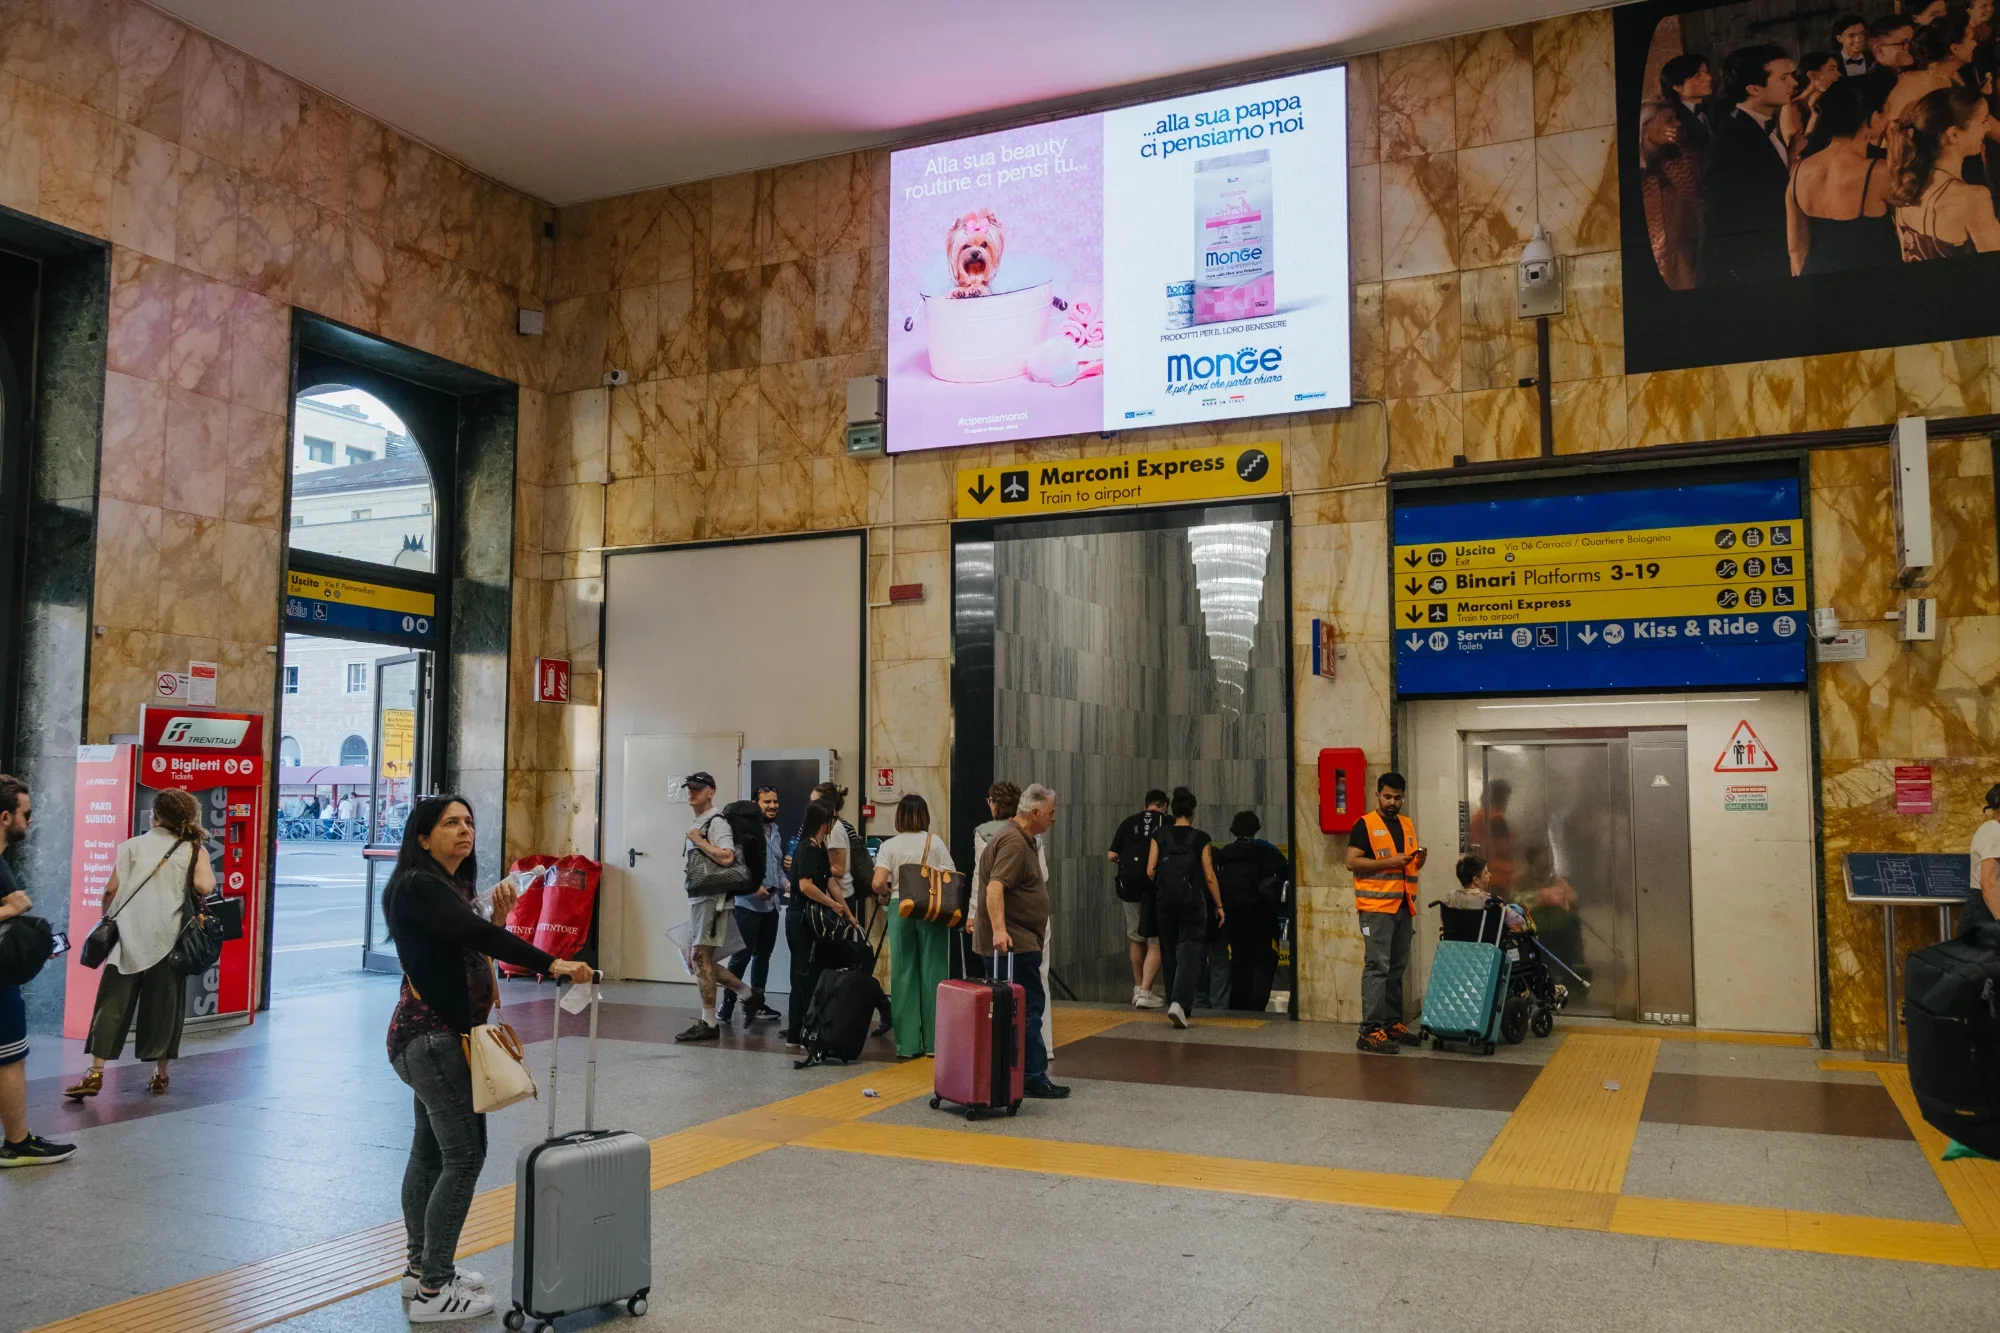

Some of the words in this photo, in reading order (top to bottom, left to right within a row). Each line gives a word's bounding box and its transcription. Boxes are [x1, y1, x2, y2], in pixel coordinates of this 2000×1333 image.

[1144, 114, 1189, 136] ...alla
[1195, 108, 1230, 127] sua
[1235, 95, 1301, 124] pappa
[1140, 138, 1157, 158] ci
[1162, 124, 1264, 159] pensiamo
[1269, 112, 1304, 136] noi
[924, 157, 959, 176] Alla
[963, 152, 995, 169] sua
[1000, 138, 1068, 163] beauty
[904, 175, 972, 200] routine
[976, 169, 992, 187] ci
[997, 159, 1048, 188] pensi
[1054, 157, 1088, 174] tu...
[1160, 331, 1199, 342] PRODOTTI
[1200, 330, 1213, 338] PER
[1223, 325, 1244, 335] LORO
[1245, 320, 1287, 331] BENESSERE
[1173, 384, 1188, 396] pet
[1188, 380, 1209, 395] food
[1210, 378, 1224, 389] che
[1225, 376, 1252, 390] parla
[1254, 373, 1282, 384] chiaro
[958, 410, 1028, 427] #cipensiamonoi
[1040, 461, 1129, 486] Marconi
[1138, 457, 1225, 480] Express
[1040, 490, 1071, 505] Train
[1076, 490, 1090, 501] to
[1095, 485, 1142, 502] airport
[1456, 544, 1496, 557] Uscita
[1504, 542, 1518, 551] Via
[1536, 539, 1572, 550] Carracci
[1582, 536, 1624, 547] Quartiere
[1627, 533, 1671, 546] Bolognina
[1456, 558, 1470, 566] Exit
[291, 575, 319, 588] Uscita
[1456, 571, 1516, 589] Binari
[1524, 568, 1601, 586] Platforms
[1610, 563, 1660, 581] 3-19
[291, 585, 301, 593] Exit
[1457, 600, 1513, 612] Marconi
[1517, 598, 1571, 612] Express
[1457, 613, 1477, 622] Train
[1480, 613, 1489, 621] to
[1491, 612, 1520, 623] airport
[1457, 628, 1503, 641] Servizi
[1633, 621, 1677, 639] Kiss
[1684, 620, 1702, 637] &
[1708, 617, 1759, 636] Ride
[1457, 642, 1483, 651] Toilets
[188, 736, 236, 745] TRENITALIA
[171, 758, 220, 773] Biglietti
[171, 772, 194, 780] Tickets
[91, 802, 111, 811] PARTI
[85, 815, 116, 824] SUBITO!
[84, 840, 97, 848] Qui
[98, 840, 115, 848] trovi
